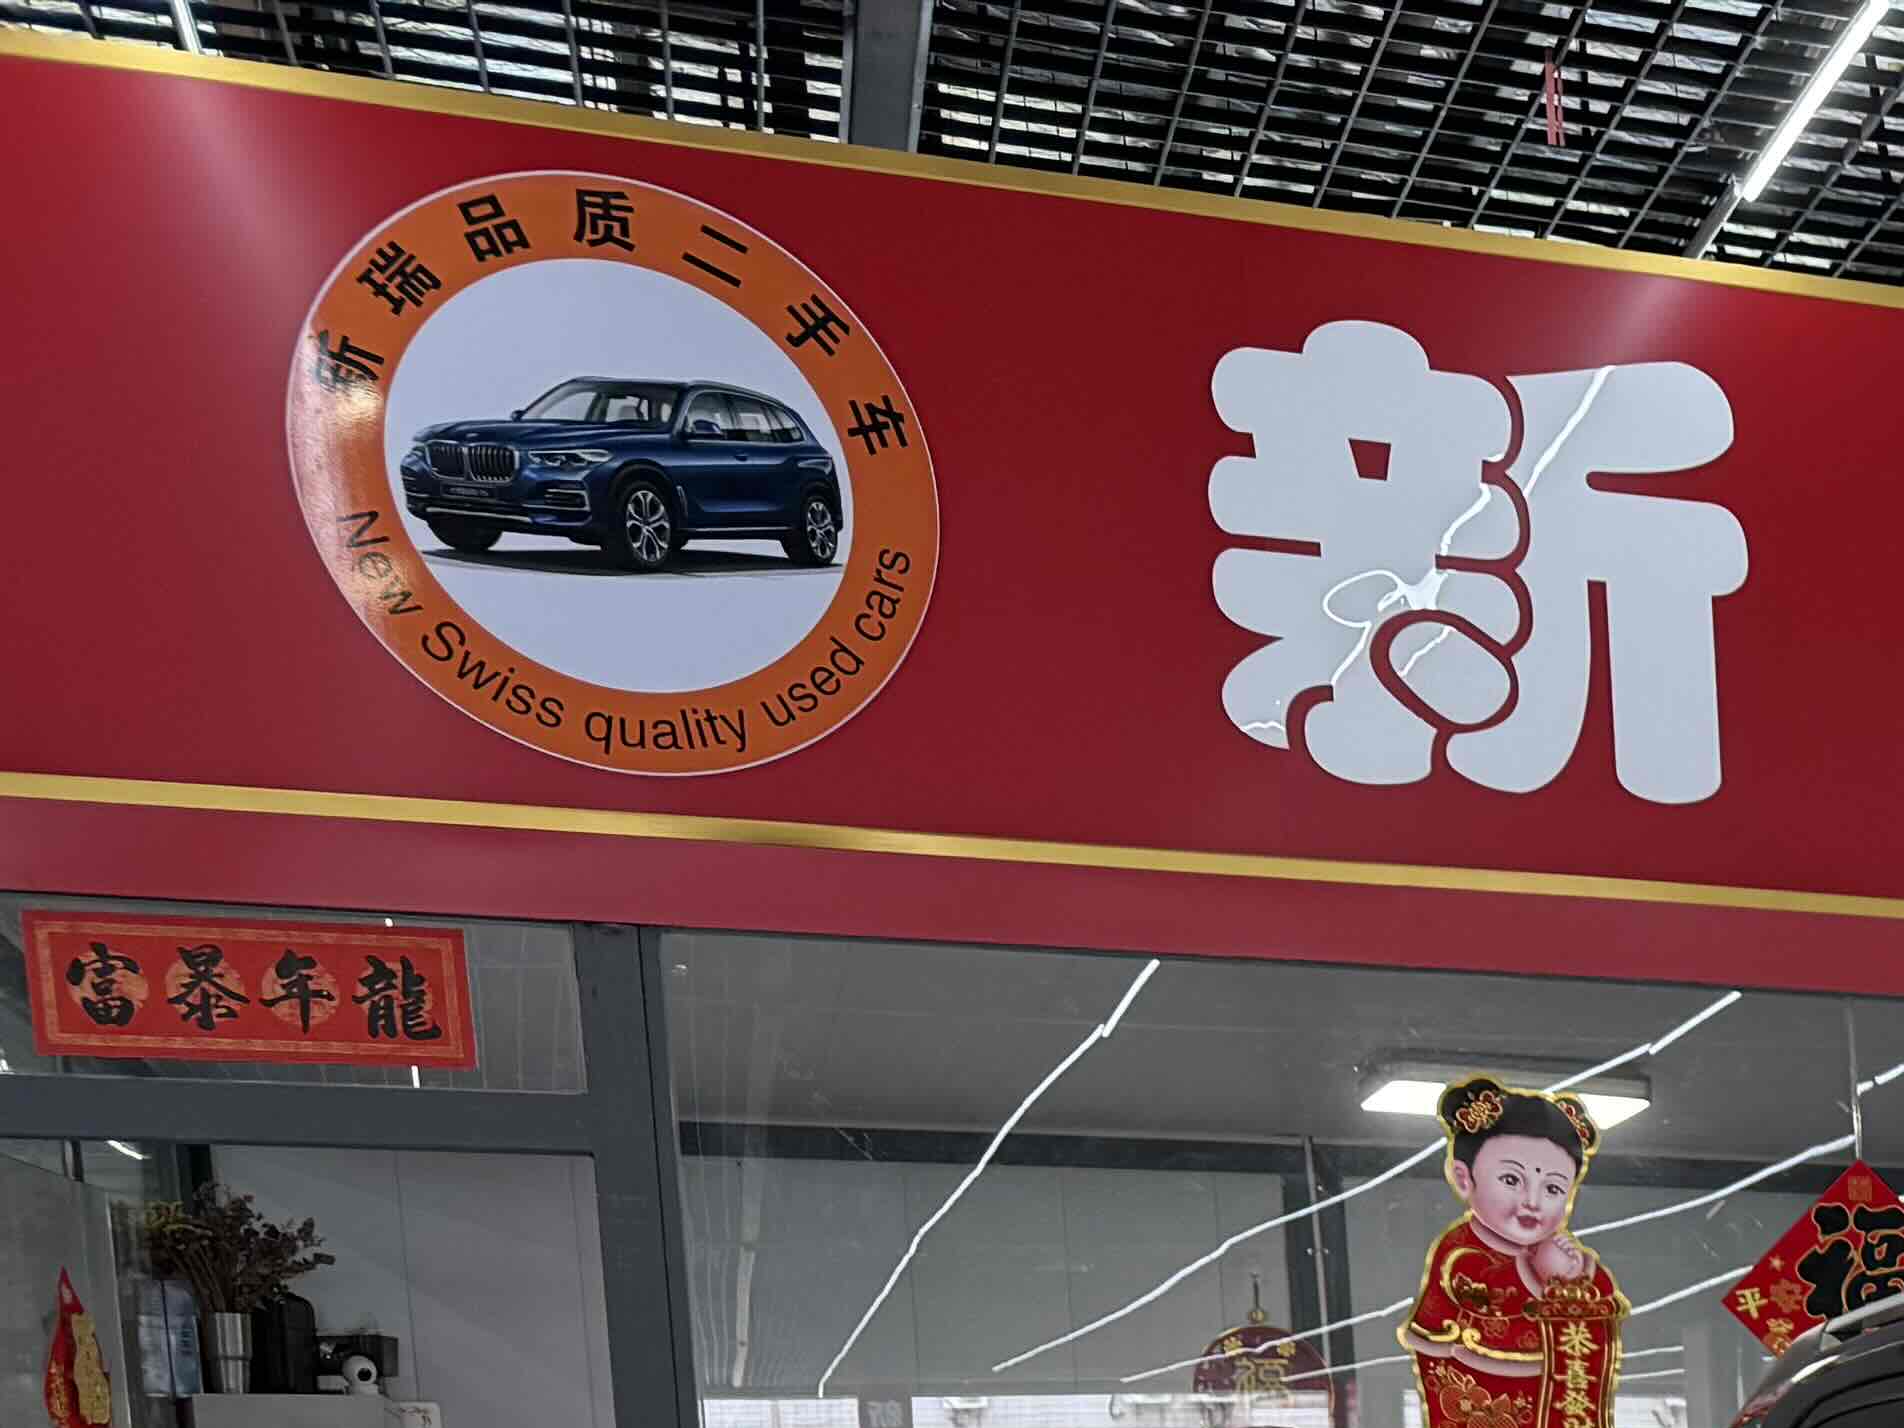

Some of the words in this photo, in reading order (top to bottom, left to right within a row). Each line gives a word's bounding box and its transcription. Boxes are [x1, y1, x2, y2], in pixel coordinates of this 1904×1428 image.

[310, 187, 909, 458] 新瑞品质二手车
[336, 508, 424, 618] New
[420, 620, 567, 729] Swiss
[583, 707, 749, 756] quality
[759, 636, 867, 730] used
[853, 546, 912, 642] cars
